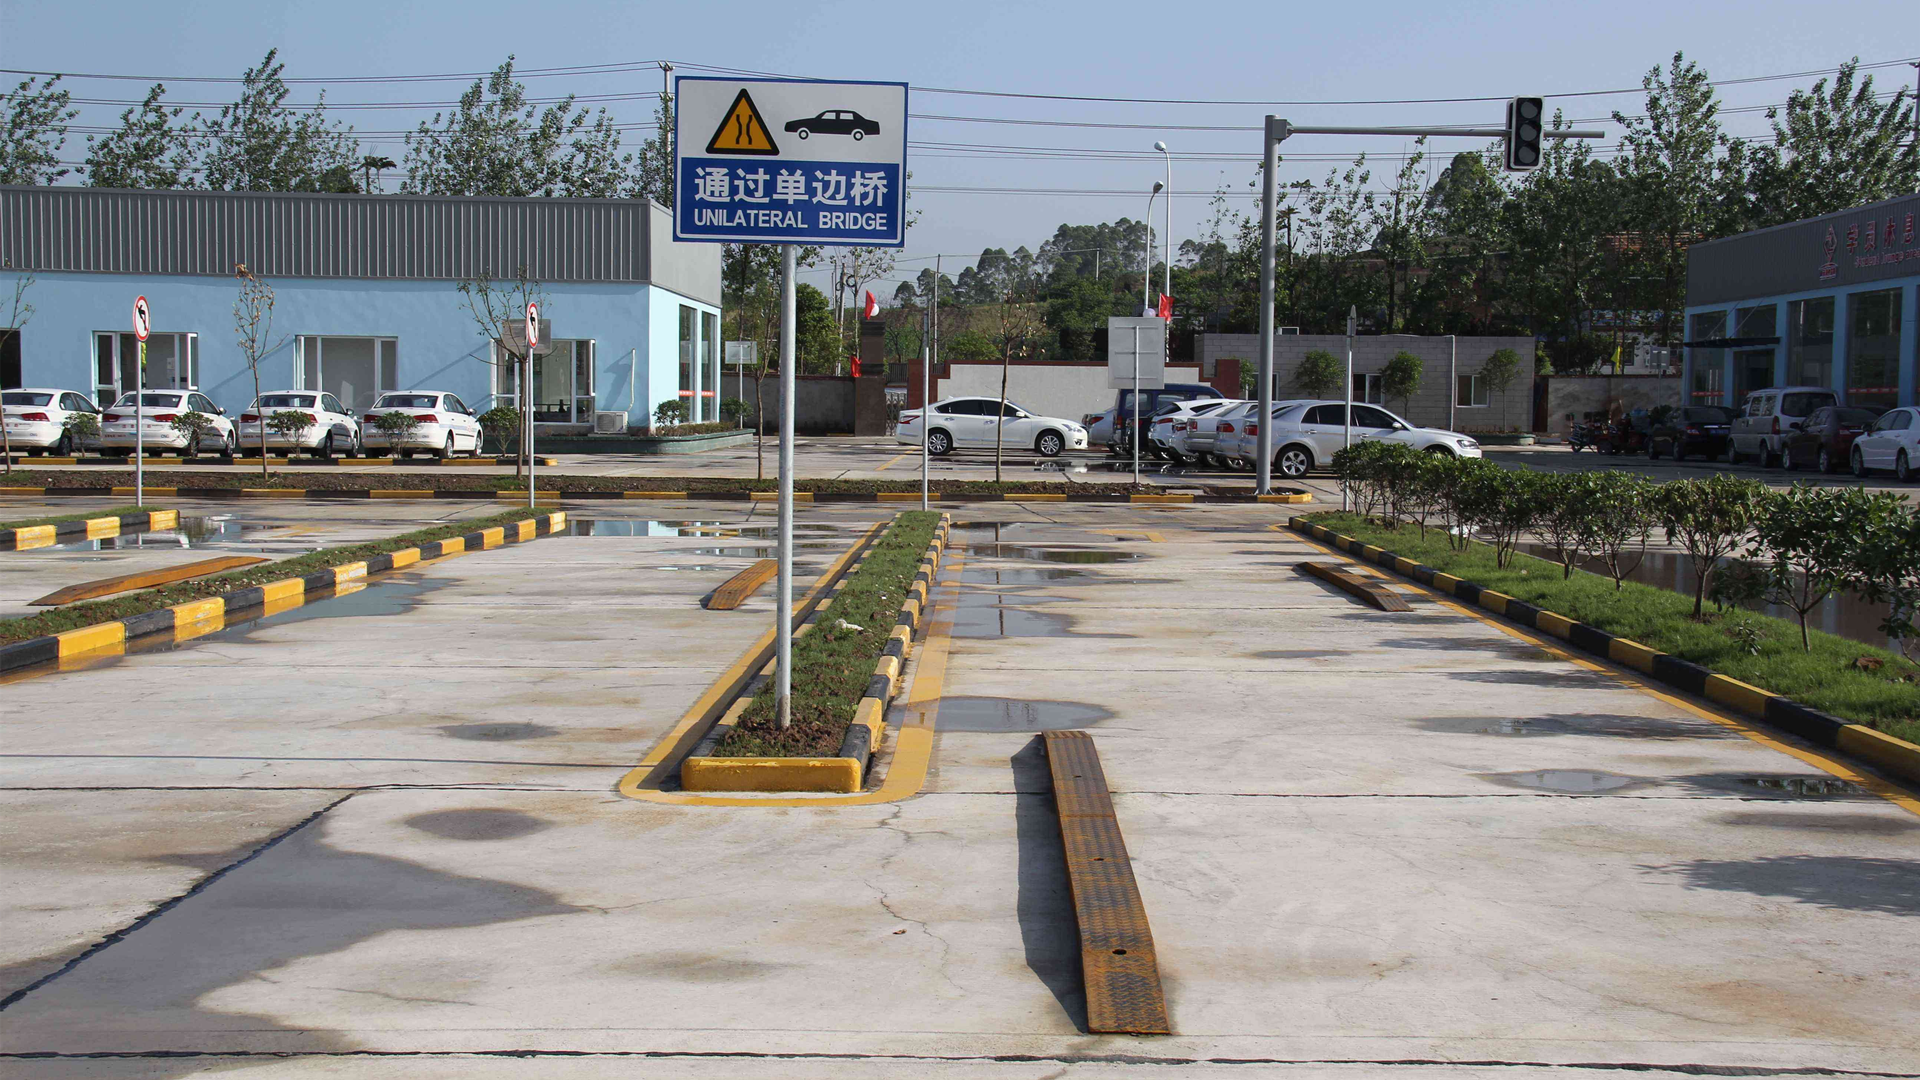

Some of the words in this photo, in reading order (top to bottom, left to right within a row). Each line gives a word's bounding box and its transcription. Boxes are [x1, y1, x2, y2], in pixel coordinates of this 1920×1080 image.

[694, 166, 888, 207] 通过单边桥
[693, 208, 808, 229] UNILATERAL
[818, 211, 887, 231] BRIDGE
